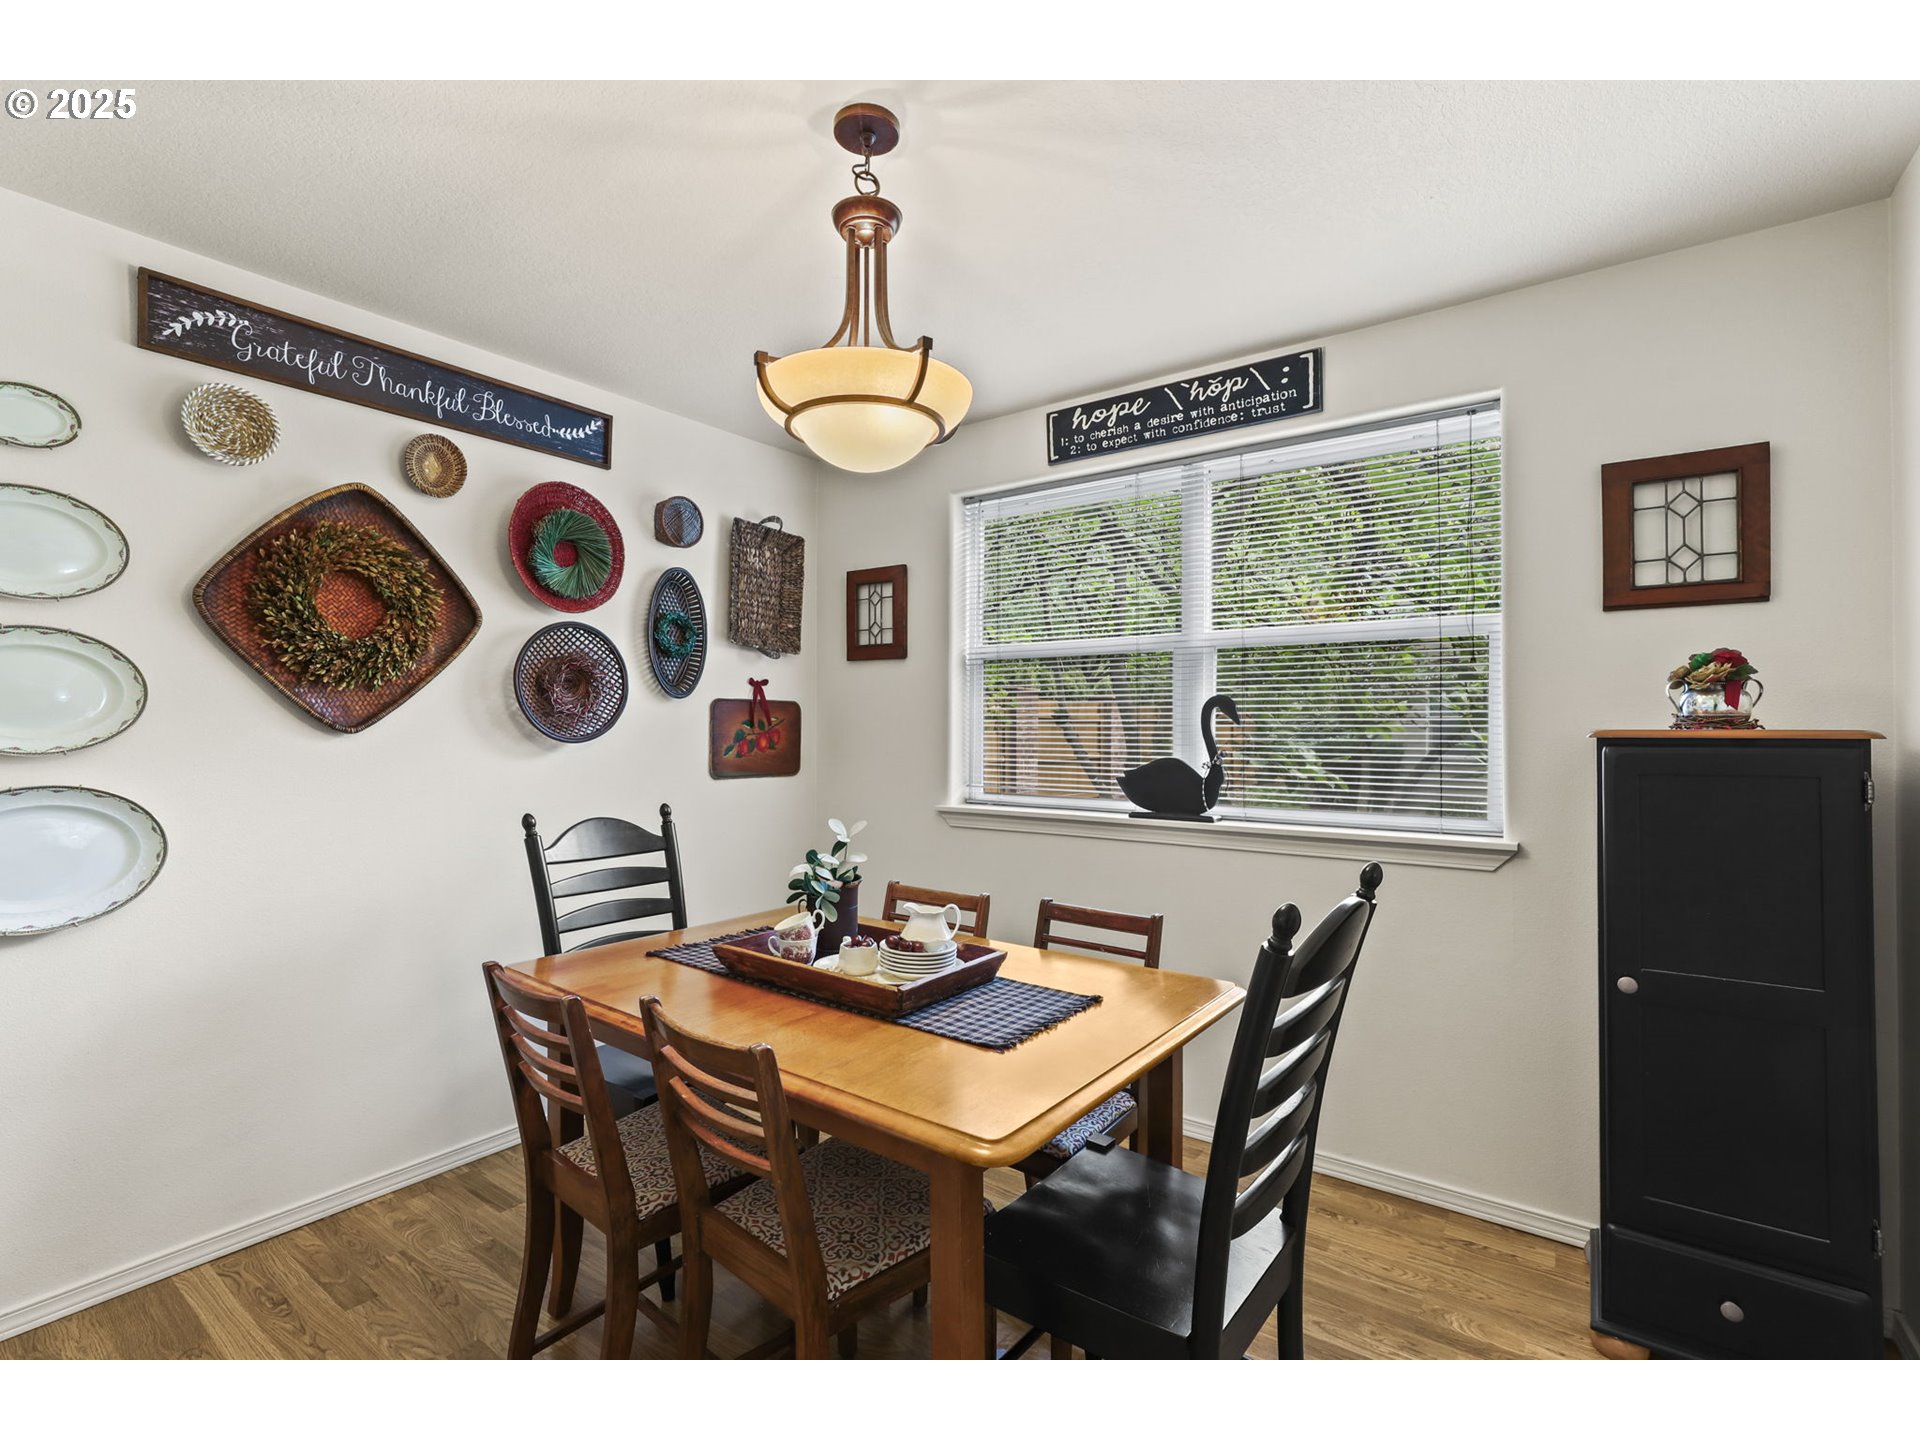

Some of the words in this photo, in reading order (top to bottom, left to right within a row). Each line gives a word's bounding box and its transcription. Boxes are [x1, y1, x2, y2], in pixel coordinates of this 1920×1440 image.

[231, 323, 348, 385] Grateful
[351, 355, 470, 419] Thankful
[472, 390, 553, 438] Blessed
[1070, 446, 1081, 455] 2:
[1086, 442, 1097, 452] to
[1102, 434, 1138, 448] expect
[1143, 427, 1167, 440] with
[1172, 412, 1245, 435] confidence:
[1251, 401, 1287, 418] trust
[1072, 397, 1152, 430] hope
[1074, 434, 1085, 443] to
[1089, 424, 1129, 440] cherish
[1134, 422, 1141, 430] a
[1147, 412, 1184, 428] desire
[1190, 405, 1215, 419] with
[1220, 388, 1297, 412] anticipation
